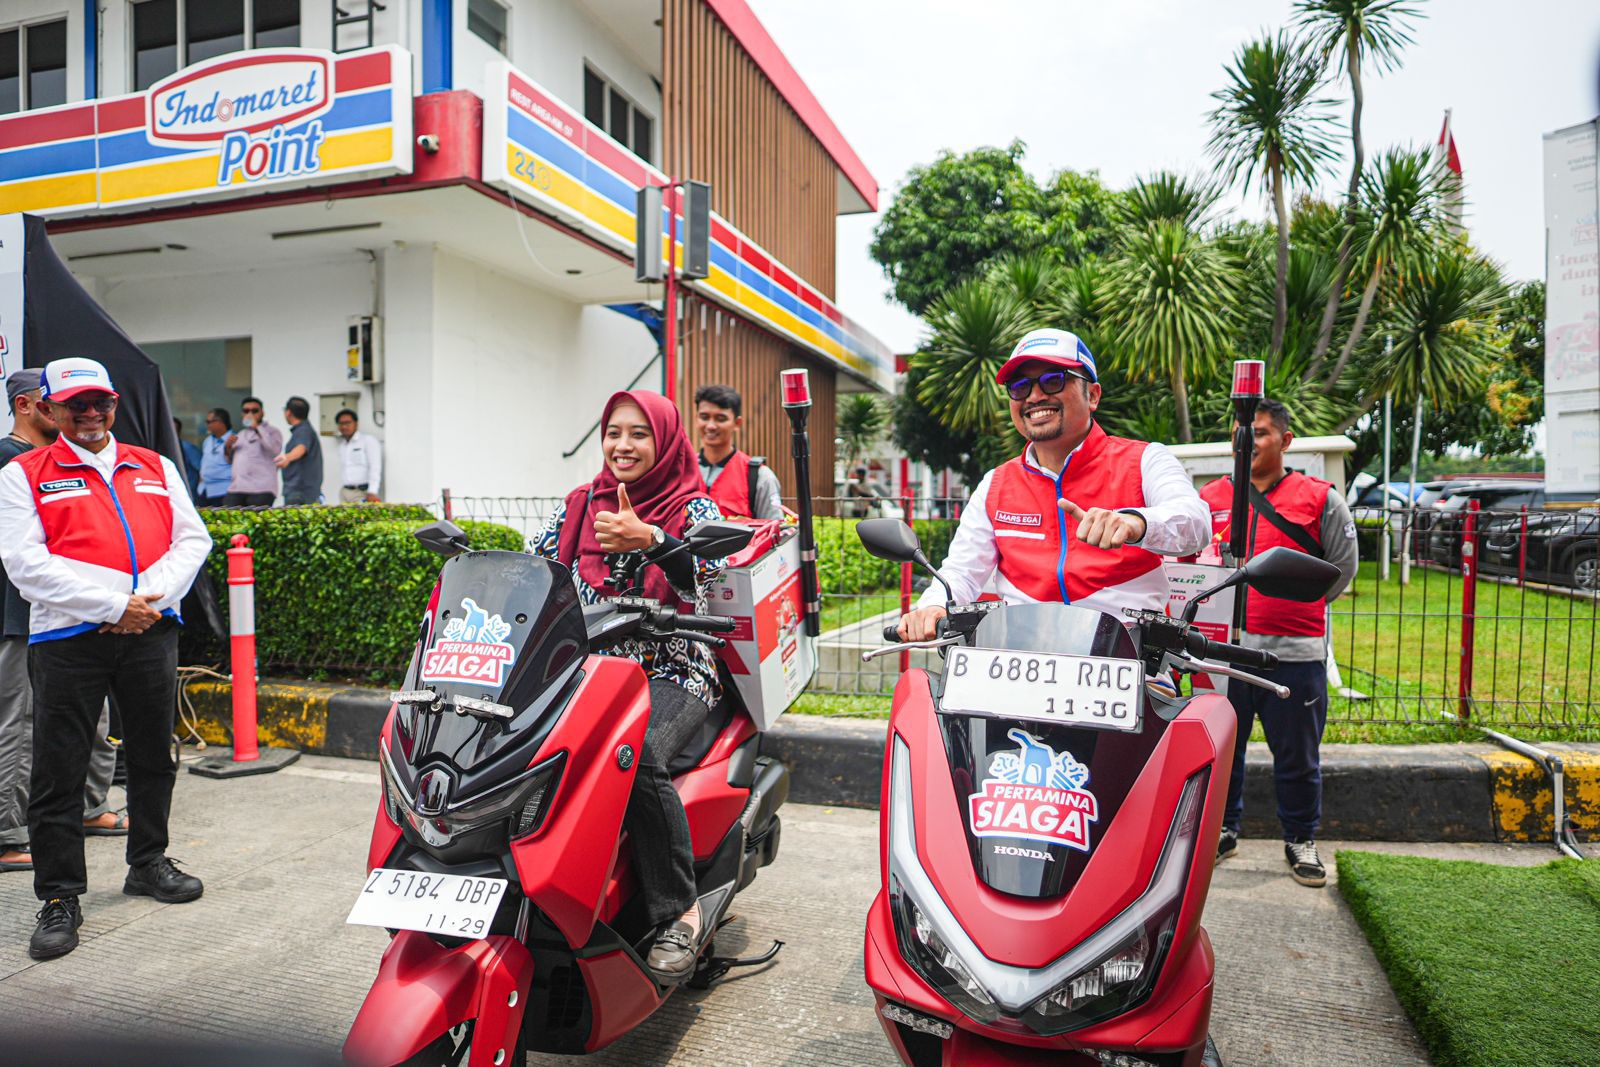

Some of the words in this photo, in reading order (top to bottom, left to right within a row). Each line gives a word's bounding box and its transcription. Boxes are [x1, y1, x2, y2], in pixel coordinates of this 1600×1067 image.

[159, 70, 318, 128] Indomaret
[219, 122, 322, 184] Point
[515, 151, 536, 182] 24
[998, 512, 1021, 523] MARS
[1022, 514, 1038, 525] EGA
[424, 654, 497, 679] SIAGA
[440, 643, 507, 659] PERTAMINA
[953, 653, 969, 677] B
[988, 655, 1058, 684] 6881
[1077, 661, 1132, 691] RAC
[993, 785, 1091, 812] PERTAMINA
[975, 800, 1083, 840] SIAGA
[993, 845, 1055, 862] HONDA
[363, 871, 383, 893] Z
[387, 872, 446, 900] 5184
[455, 879, 502, 905] DBP
